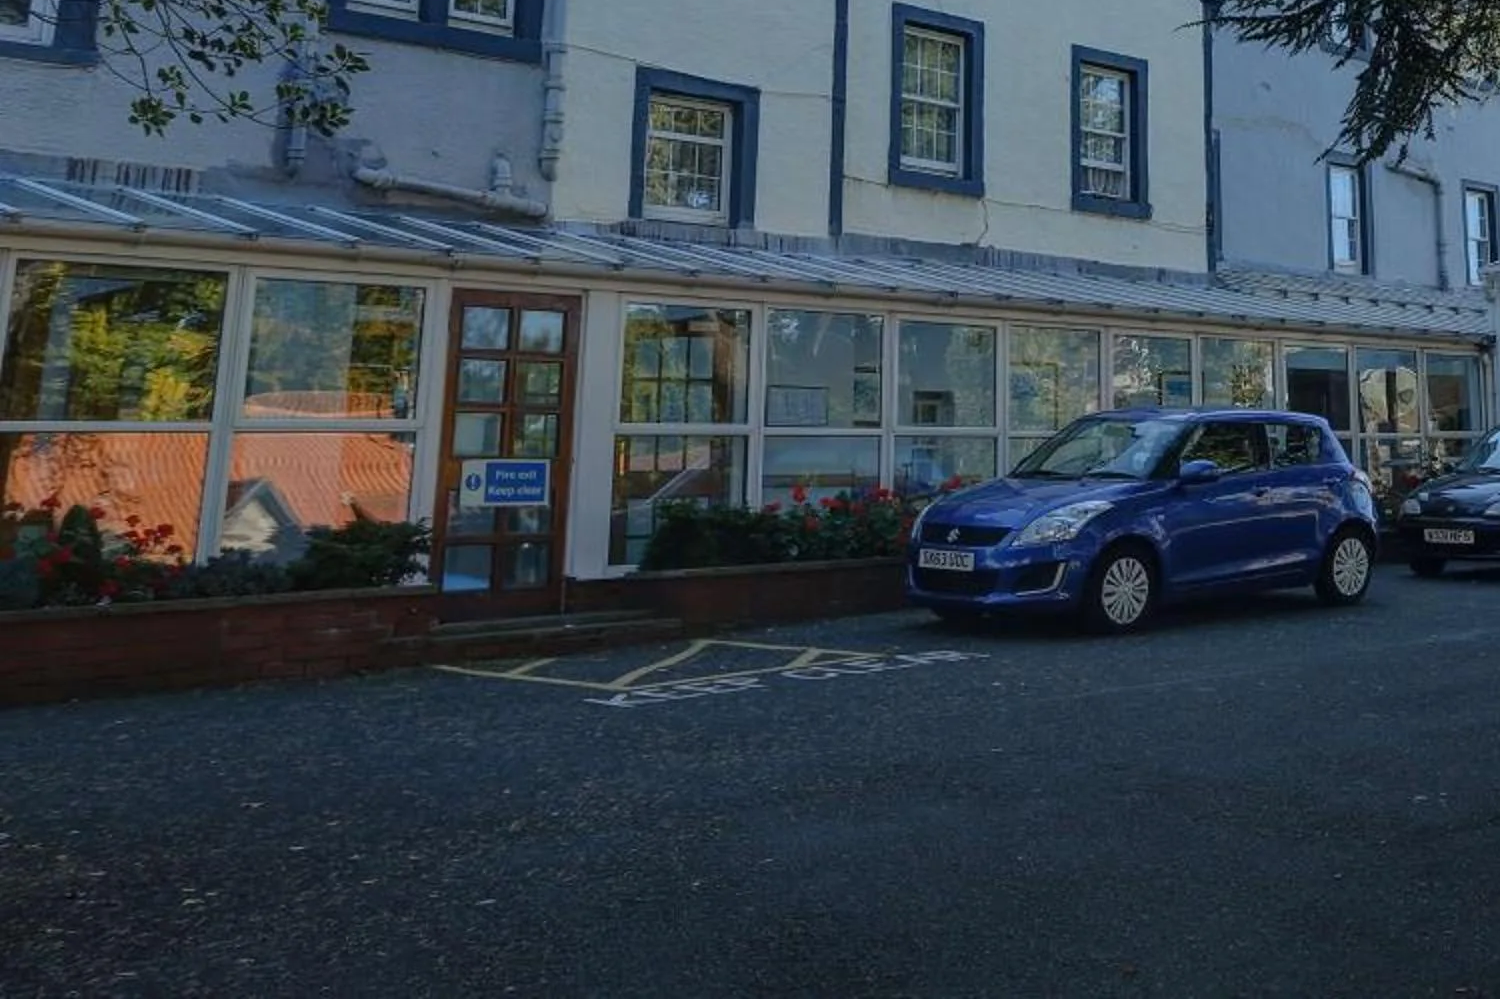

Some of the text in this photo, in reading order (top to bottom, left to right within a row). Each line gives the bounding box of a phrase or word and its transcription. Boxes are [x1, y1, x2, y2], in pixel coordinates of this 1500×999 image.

[495, 470, 537, 480] Fire exit
[488, 484, 542, 498] Keep clear
